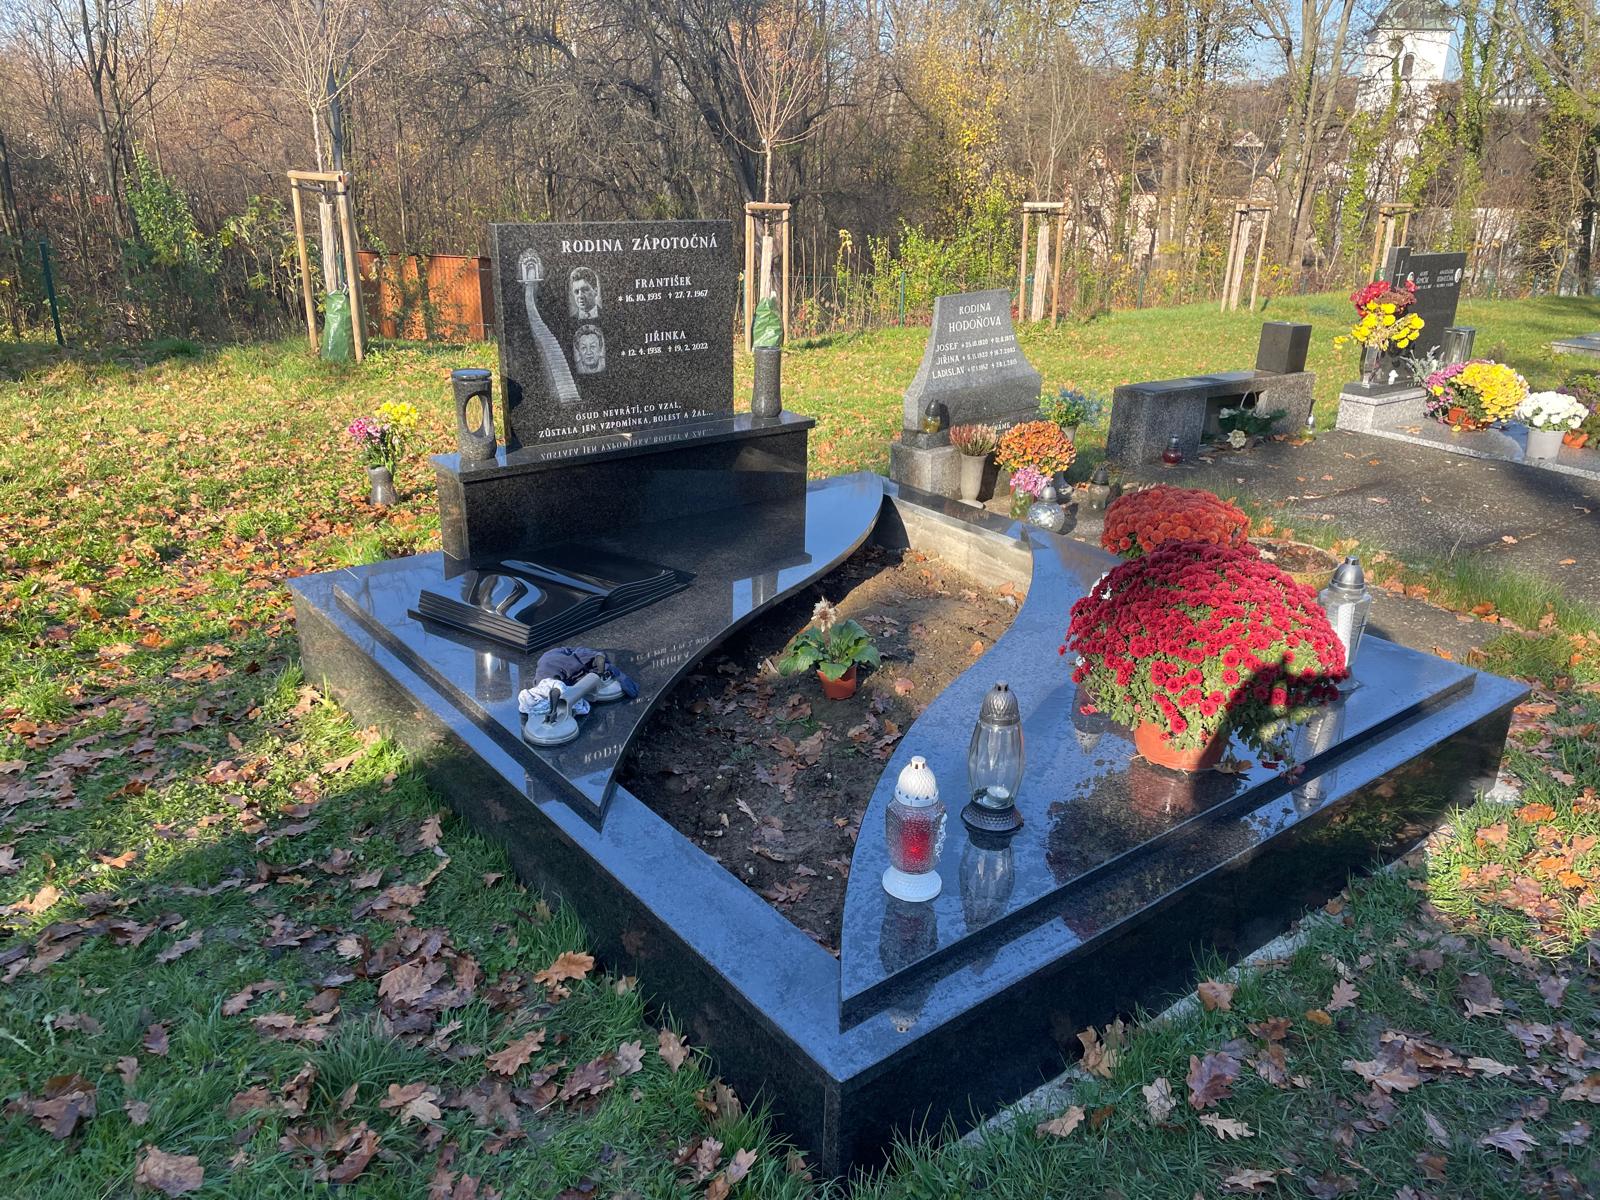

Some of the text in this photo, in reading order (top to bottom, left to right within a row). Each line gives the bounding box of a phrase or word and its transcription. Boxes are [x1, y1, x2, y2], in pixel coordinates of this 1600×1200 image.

[562, 233, 718, 253] RODINA ZÁPOTOČNÁ
[635, 274, 692, 288] FRANTIŠEK
[959, 303, 991, 315] RODINA
[645, 330, 687, 343] JIŘINKA
[935, 342, 959, 352] JOSEF
[936, 354, 960, 365] JIŘINA
[932, 365, 965, 379] LADISLAV
[575, 411, 599, 421] OSUD
[539, 426, 578, 438] ZŮSTALA
[582, 424, 596, 434] JEN
[652, 412, 681, 423] BOLEST
